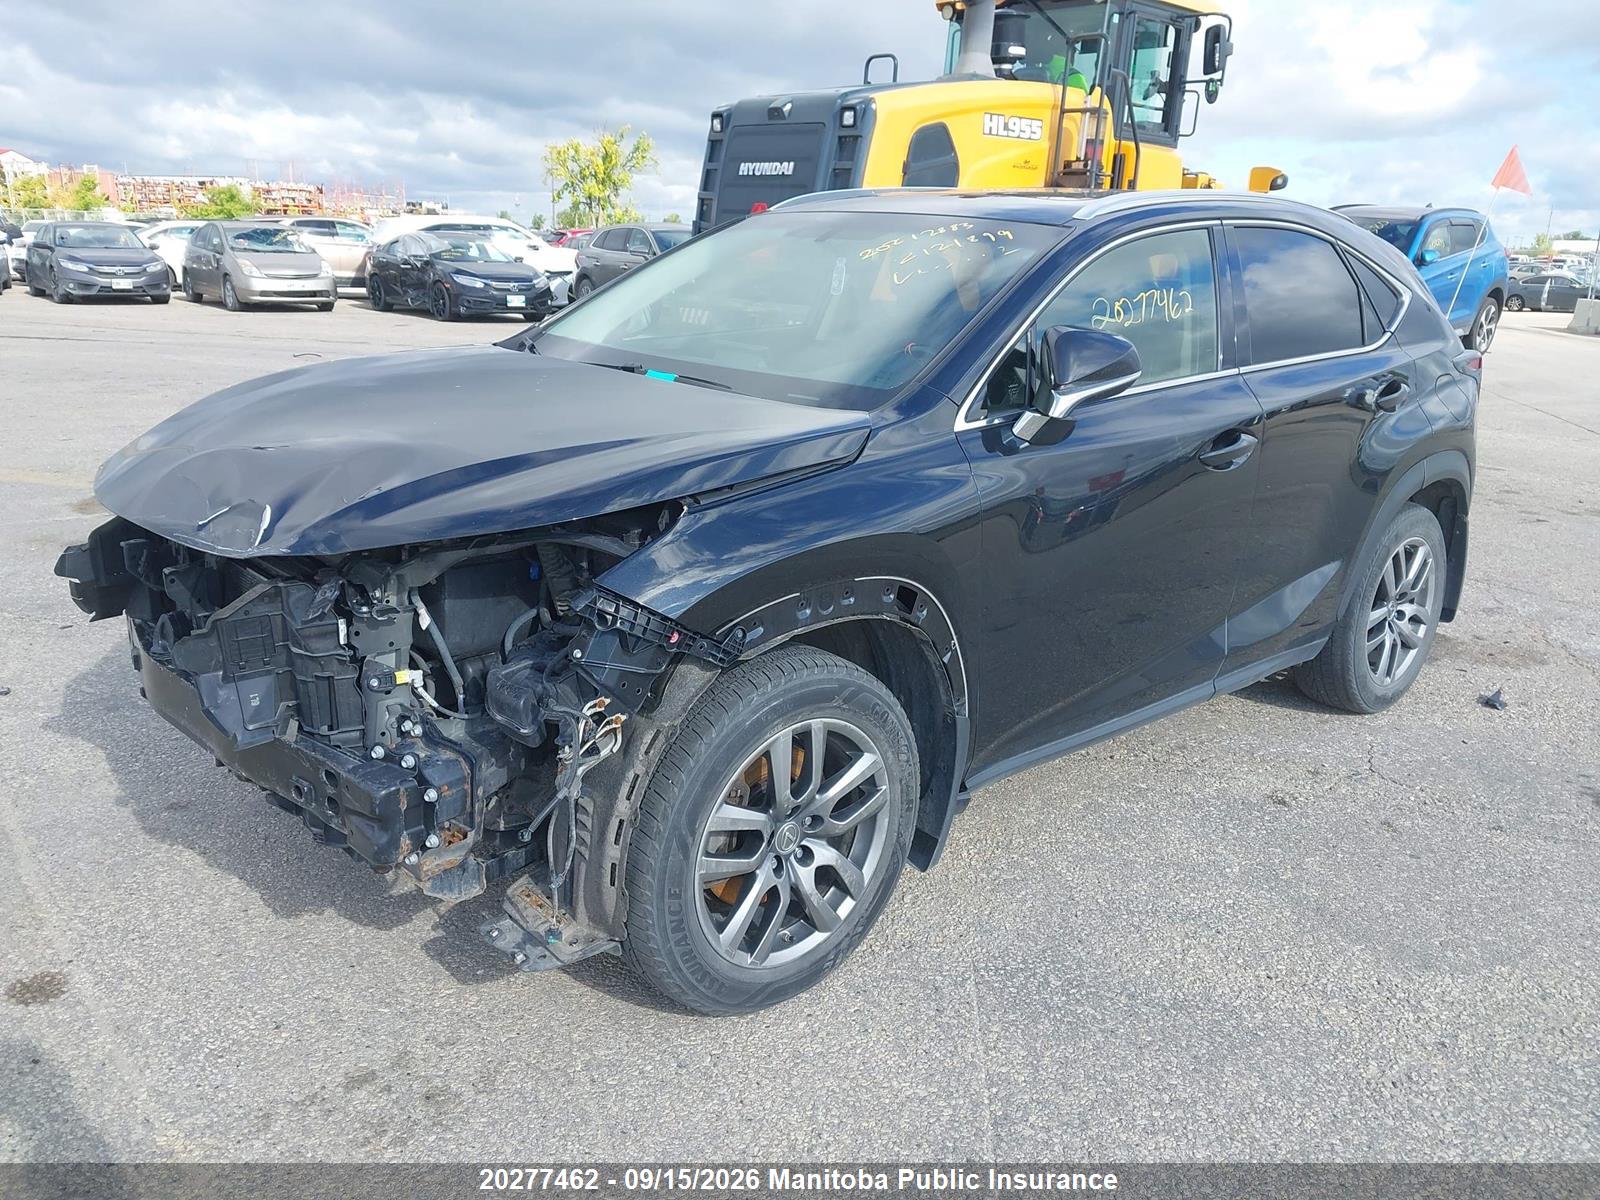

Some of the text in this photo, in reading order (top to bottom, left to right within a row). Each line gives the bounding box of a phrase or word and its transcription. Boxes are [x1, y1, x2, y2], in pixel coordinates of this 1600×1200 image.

[983, 112, 1043, 140] HL955
[738, 161, 795, 176] HYUNDAI
[1091, 287, 1194, 330] 20277462
